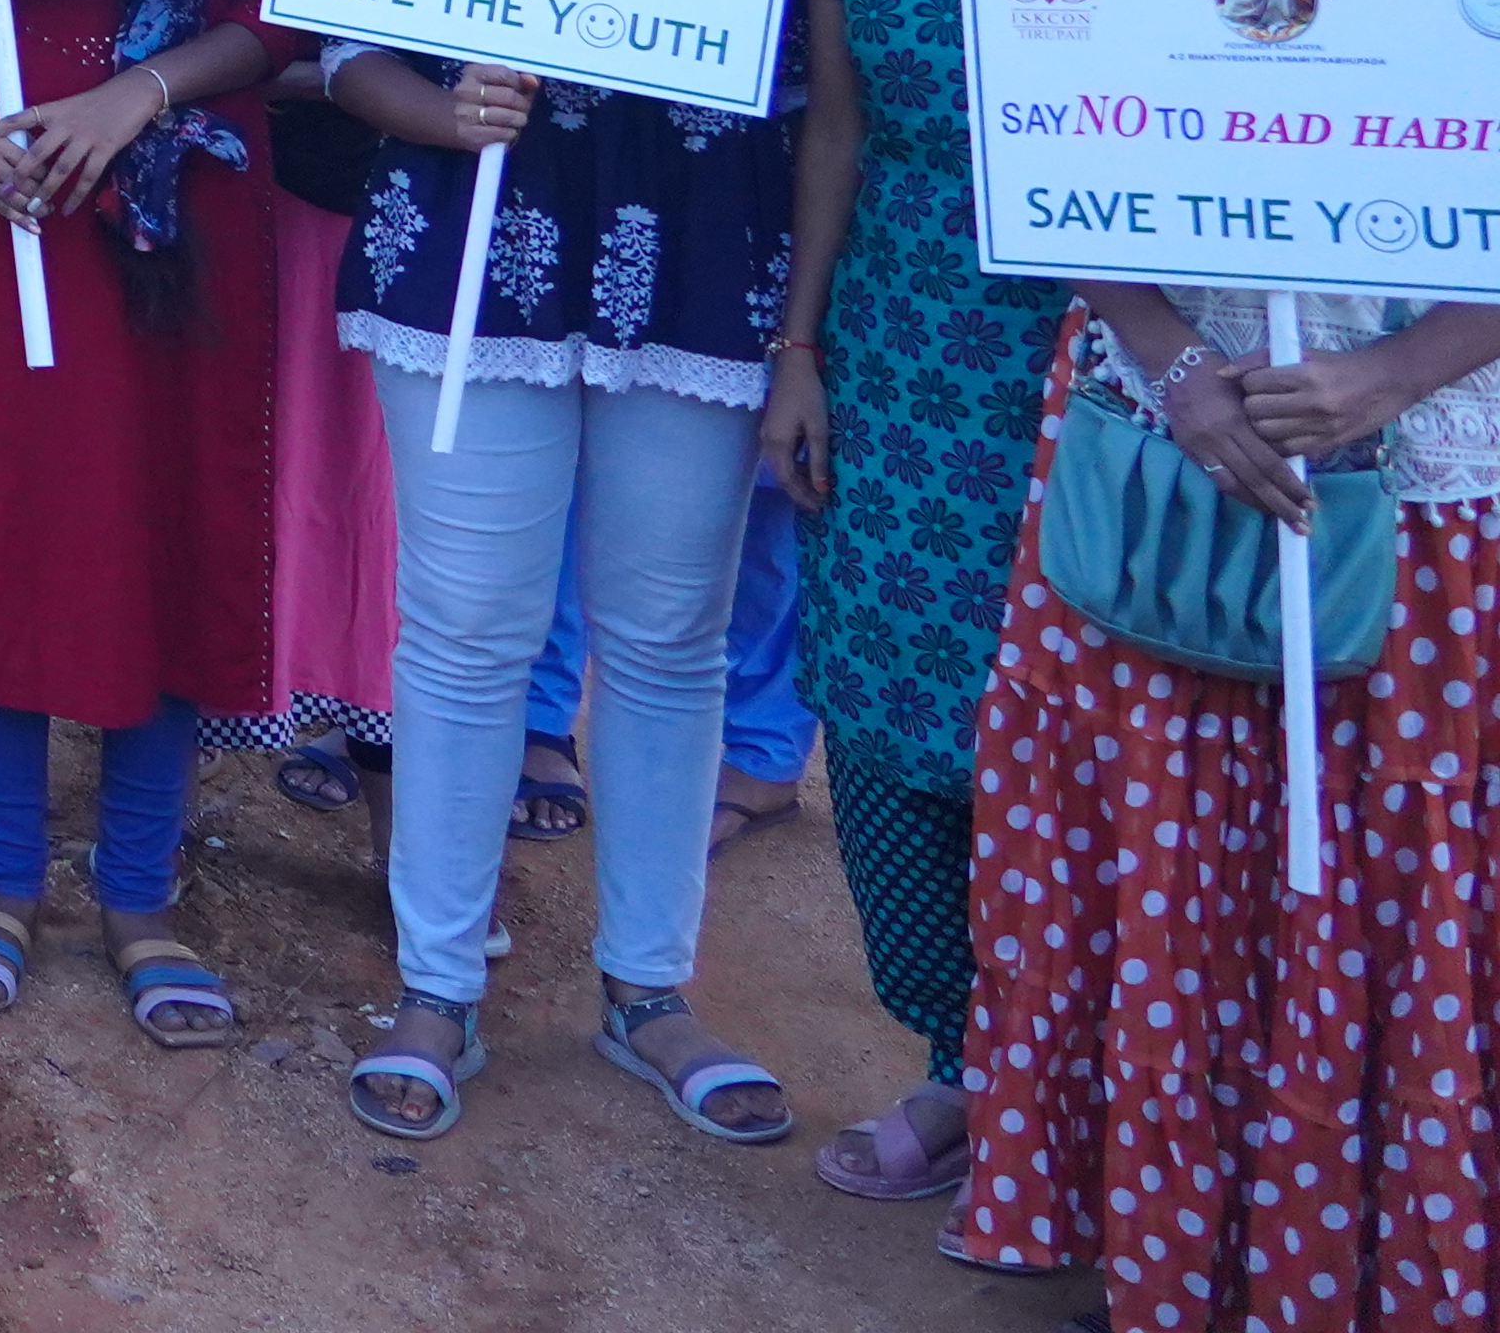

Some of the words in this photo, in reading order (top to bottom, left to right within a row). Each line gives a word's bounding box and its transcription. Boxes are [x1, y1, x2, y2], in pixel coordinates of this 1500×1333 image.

[1010, 12, 1091, 26] ISKCON
[1016, 27, 1091, 42] TIRUPATI
[1001, 102, 1070, 136] SAY
[1070, 93, 1150, 139] NO
[1155, 106, 1206, 141] TO
[1218, 110, 1333, 146] BAD
[1349, 113, 1500, 156] HABI
[1026, 186, 1157, 234] SAVE
[1178, 194, 1294, 241] THE
